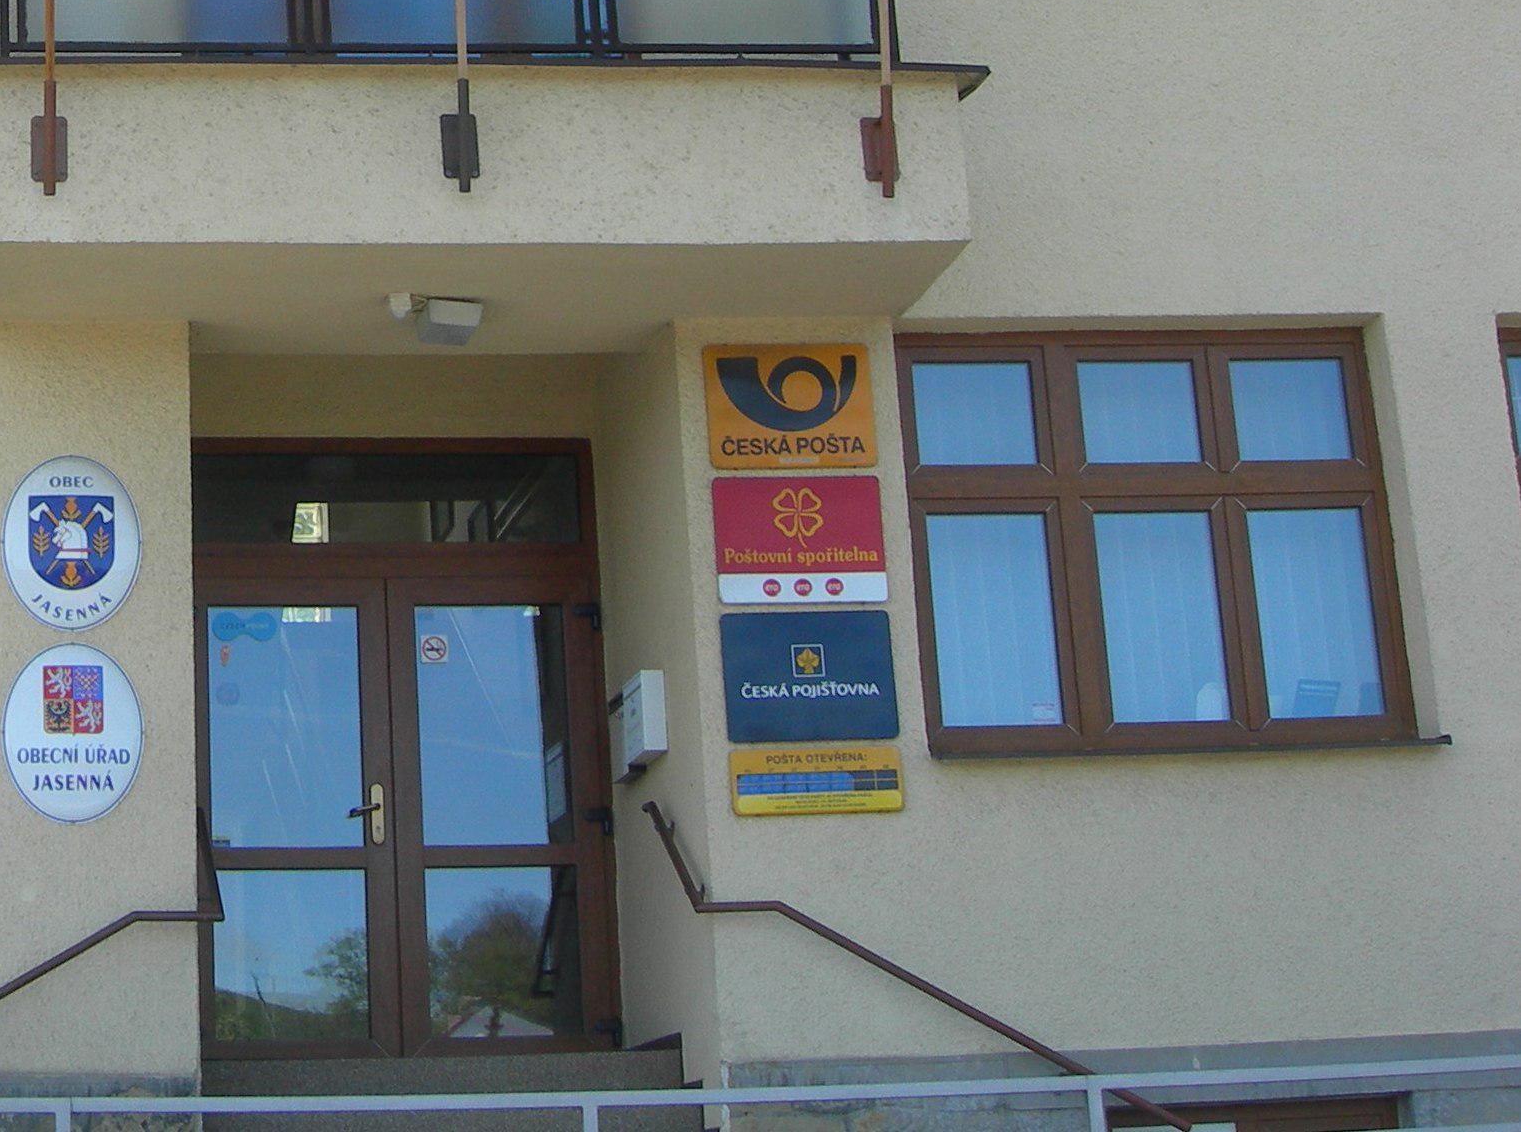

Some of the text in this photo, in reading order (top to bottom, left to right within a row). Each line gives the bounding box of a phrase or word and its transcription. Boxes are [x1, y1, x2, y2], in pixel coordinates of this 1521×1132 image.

[721, 433, 865, 456] ČESKÁ POŠTA
[49, 476, 94, 488] OBEC
[724, 546, 878, 566] Poštovní spořitelna
[31, 593, 112, 621] JASENNÁ
[741, 681, 879, 698] ČESKÁ POJIŠŤOVNA
[17, 743, 131, 764] OBECNÍ ÚŘAD
[766, 754, 803, 765] POŠTA
[33, 770, 114, 791] JASENNÁ
